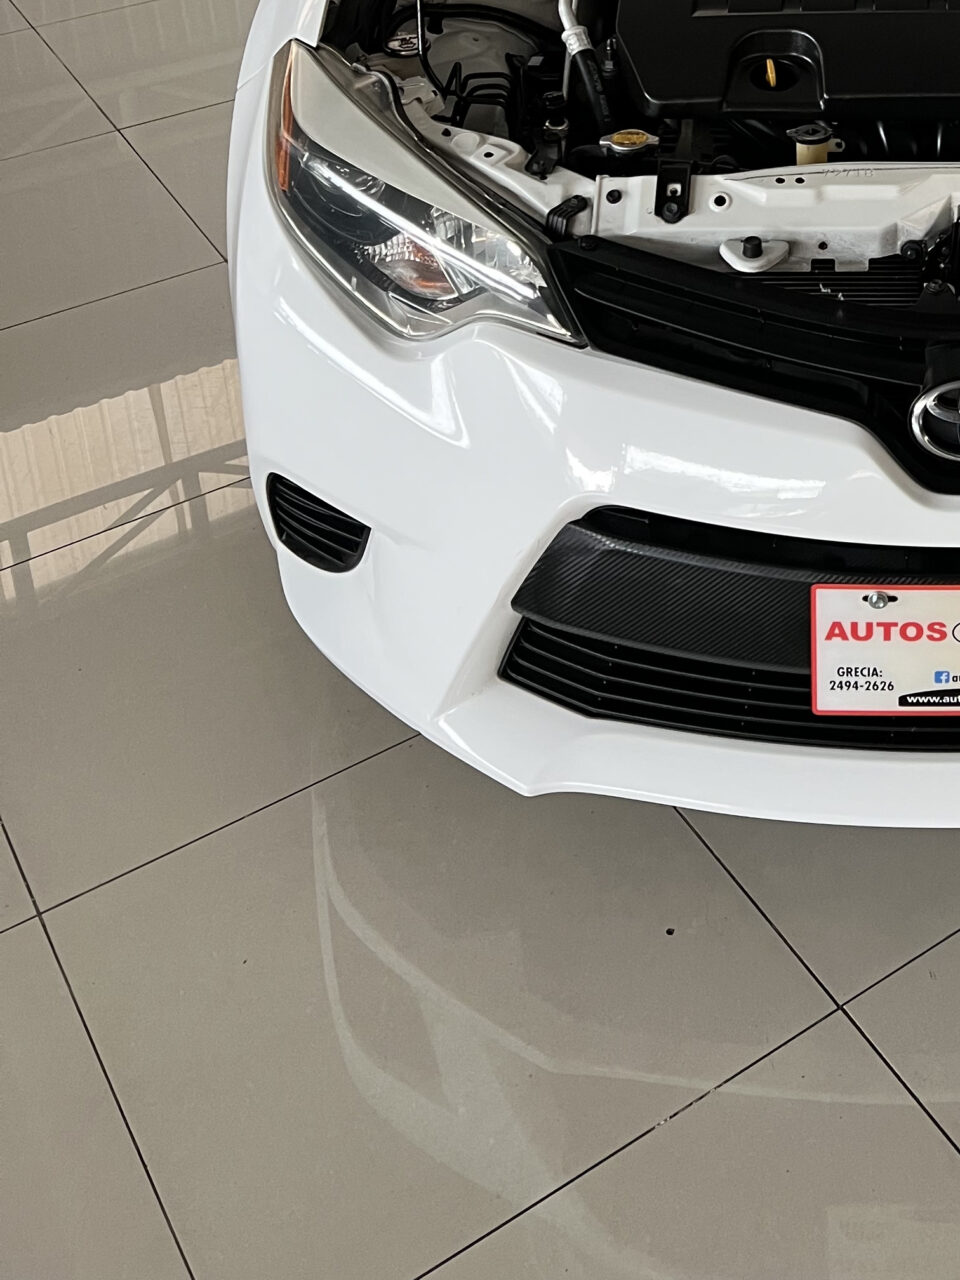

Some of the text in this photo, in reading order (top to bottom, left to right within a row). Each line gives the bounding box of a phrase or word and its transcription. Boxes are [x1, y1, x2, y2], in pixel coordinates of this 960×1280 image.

[825, 620, 948, 643] AUTOS
[836, 666, 883, 678] GRECIA:
[829, 680, 895, 692] 2494-2626
